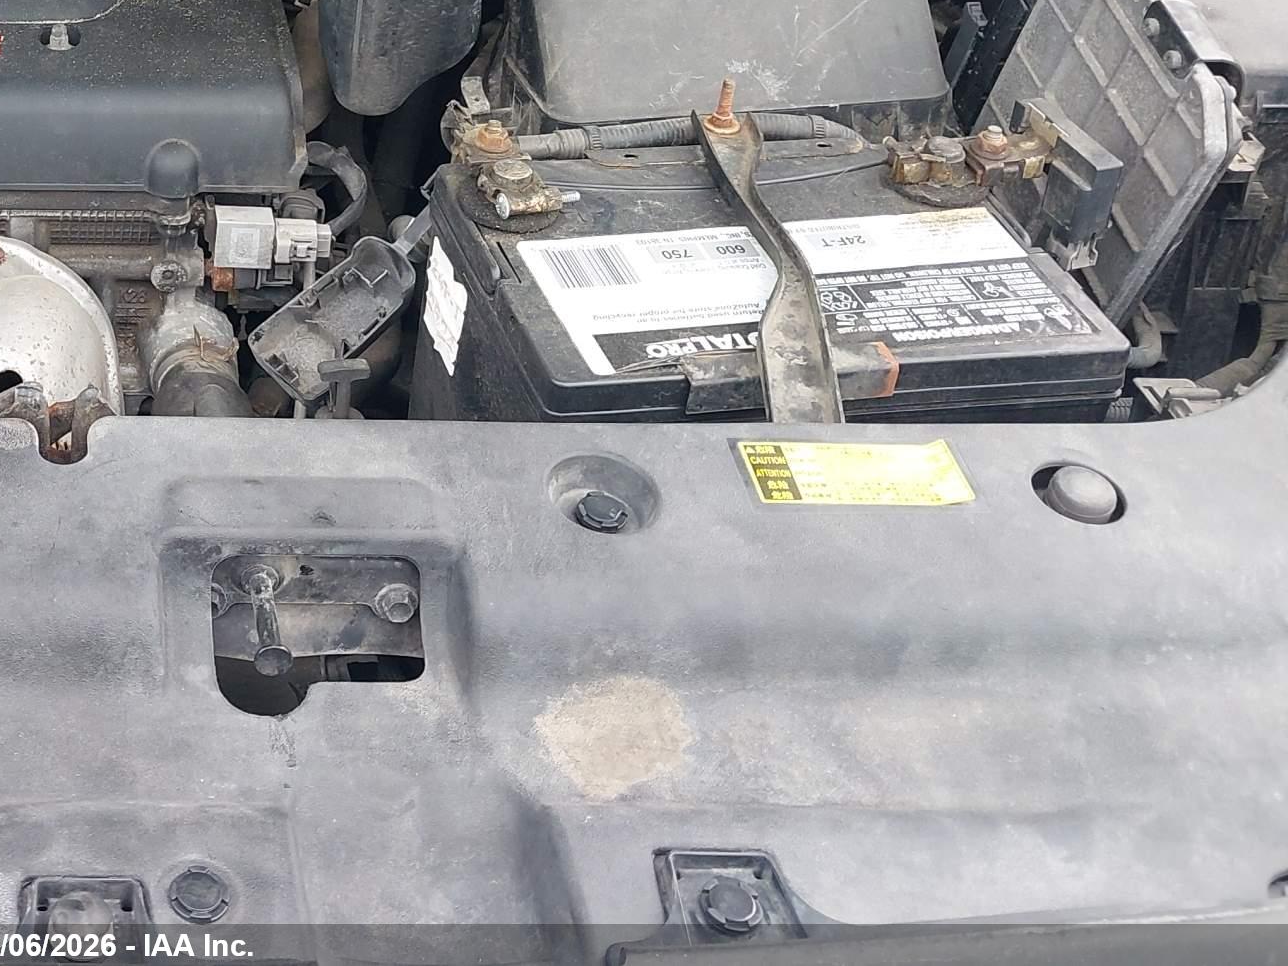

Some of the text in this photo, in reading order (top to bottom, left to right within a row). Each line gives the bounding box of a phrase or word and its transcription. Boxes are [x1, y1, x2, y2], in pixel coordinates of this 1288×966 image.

[821, 235, 865, 247] 24F-T
[660, 244, 745, 260] 600 750
[756, 469, 791, 477] ATTENTION
